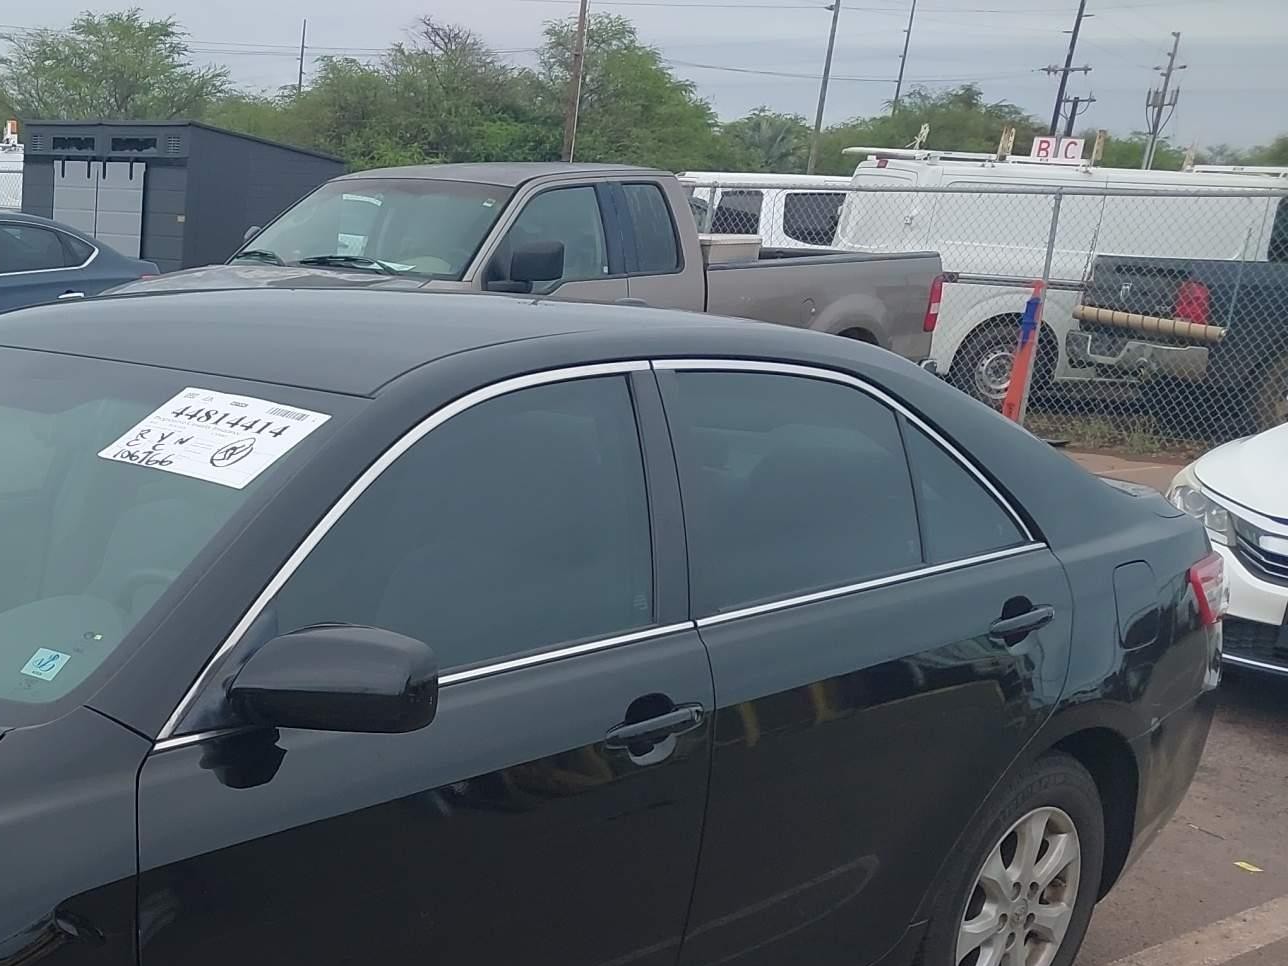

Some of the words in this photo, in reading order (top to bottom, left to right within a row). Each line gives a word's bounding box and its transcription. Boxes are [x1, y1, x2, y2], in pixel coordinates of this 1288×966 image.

[1036, 140, 1050, 158] B
[1064, 141, 1078, 159] C
[171, 405, 291, 438] 44814414
